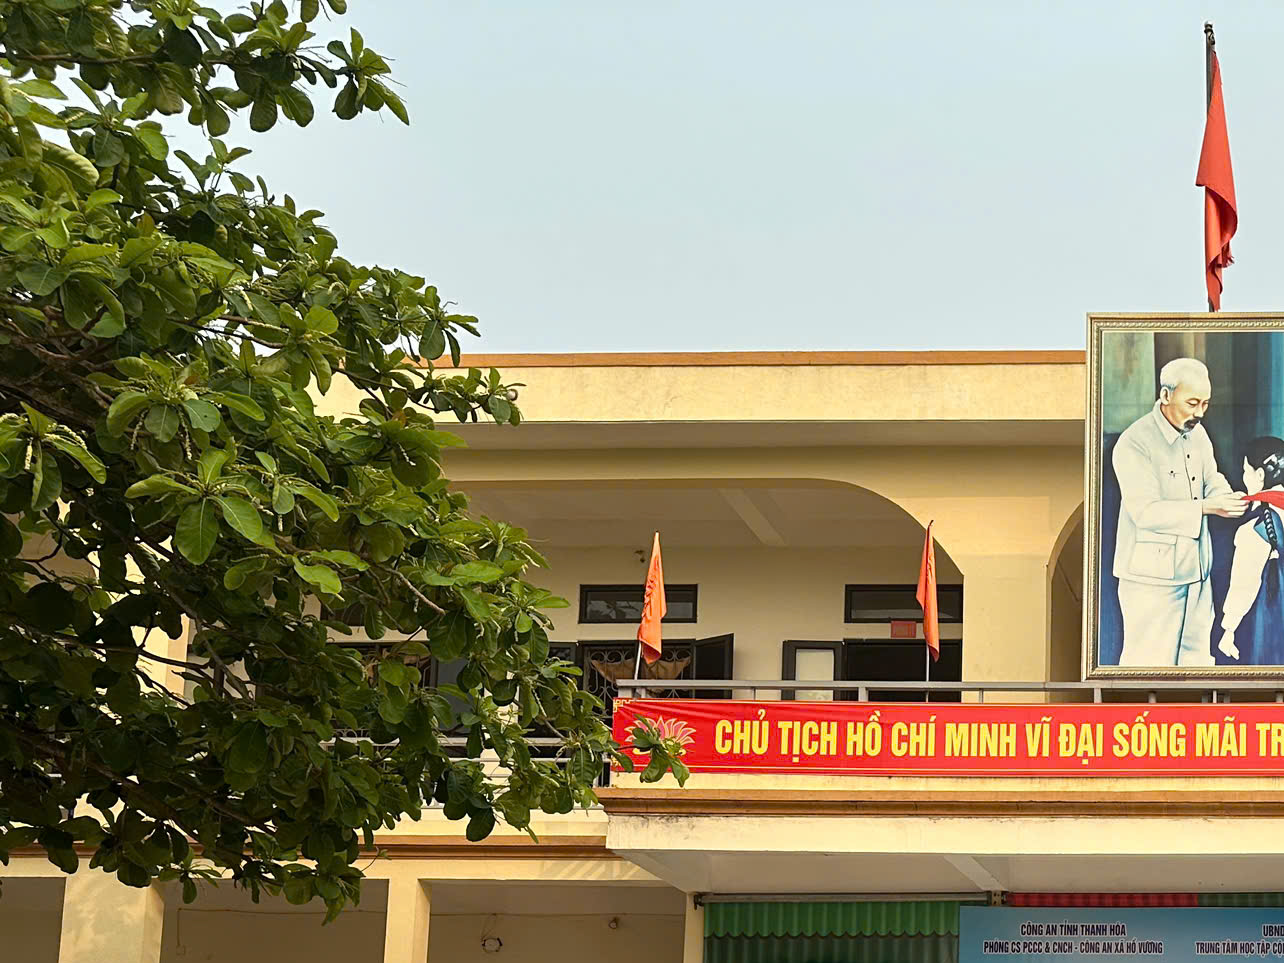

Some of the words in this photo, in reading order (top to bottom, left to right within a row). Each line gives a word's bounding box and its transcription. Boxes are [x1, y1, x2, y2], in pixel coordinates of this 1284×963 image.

[716, 709, 768, 754] CHỦ
[778, 721, 837, 762] TỊCH
[847, 711, 881, 756] HỒ
[892, 716, 936, 756] CHÍ
[945, 723, 1016, 756] MINH
[1026, 717, 1052, 756] VĨ
[1059, 724, 1103, 764] ĐẠI
[1113, 711, 1186, 757] SỐNG
[1196, 716, 1246, 756] MÃI
